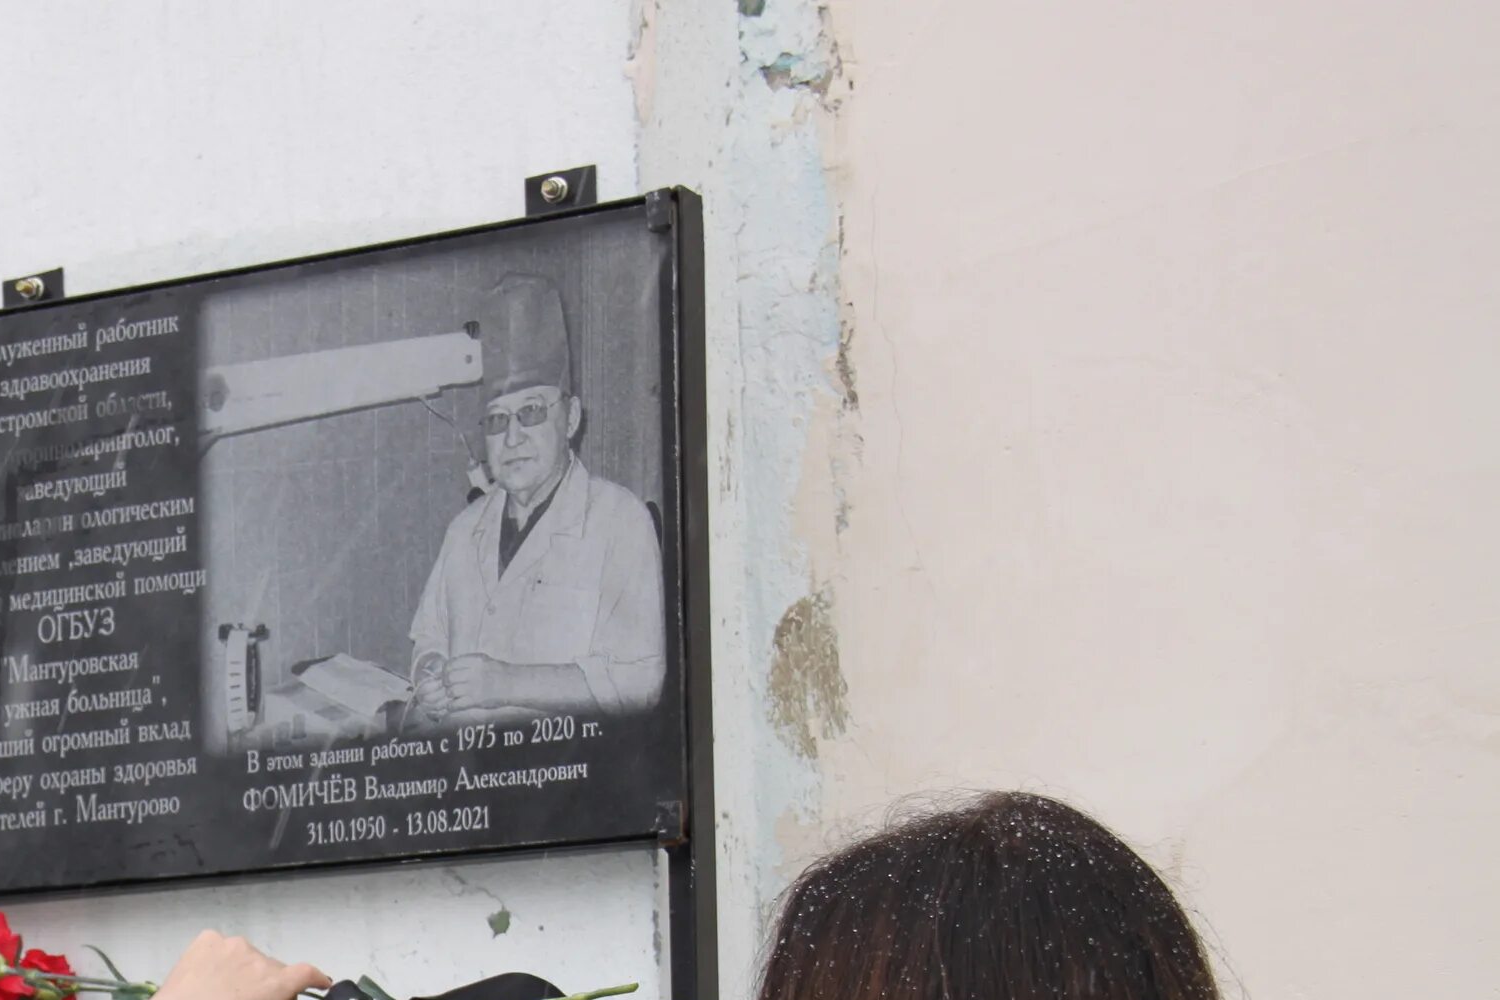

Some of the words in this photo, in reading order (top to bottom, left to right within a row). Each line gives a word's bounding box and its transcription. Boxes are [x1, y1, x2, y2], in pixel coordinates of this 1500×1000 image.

[96, 314, 179, 352] работник
[0, 355, 151, 398] здравоохранения
[8, 571, 127, 612] медицинской
[133, 568, 208, 597] помощи
[37, 607, 117, 645] ОГБУЗ
[41, 718, 131, 759] огромный
[137, 719, 192, 745] вклад
[246, 751, 261, 775] В
[266, 754, 304, 773] этом
[310, 746, 364, 768] здании
[371, 737, 435, 767] работал
[439, 739, 450, 755] с
[456, 723, 497, 751] 1975
[503, 730, 525, 748] по
[531, 715, 575, 746] 2020
[581, 721, 604, 740] гг.
[39, 765, 106, 796] охраны
[113, 755, 198, 785] здоровья
[242, 774, 358, 814] ФОМИЧЁВ
[365, 773, 449, 803] Владимир
[455, 761, 589, 794] Александрович
[53, 809, 68, 827] г.
[76, 792, 181, 825] Мантурово
[307, 815, 386, 847] 31.10.1950
[406, 806, 491, 838] 13.08.2021
